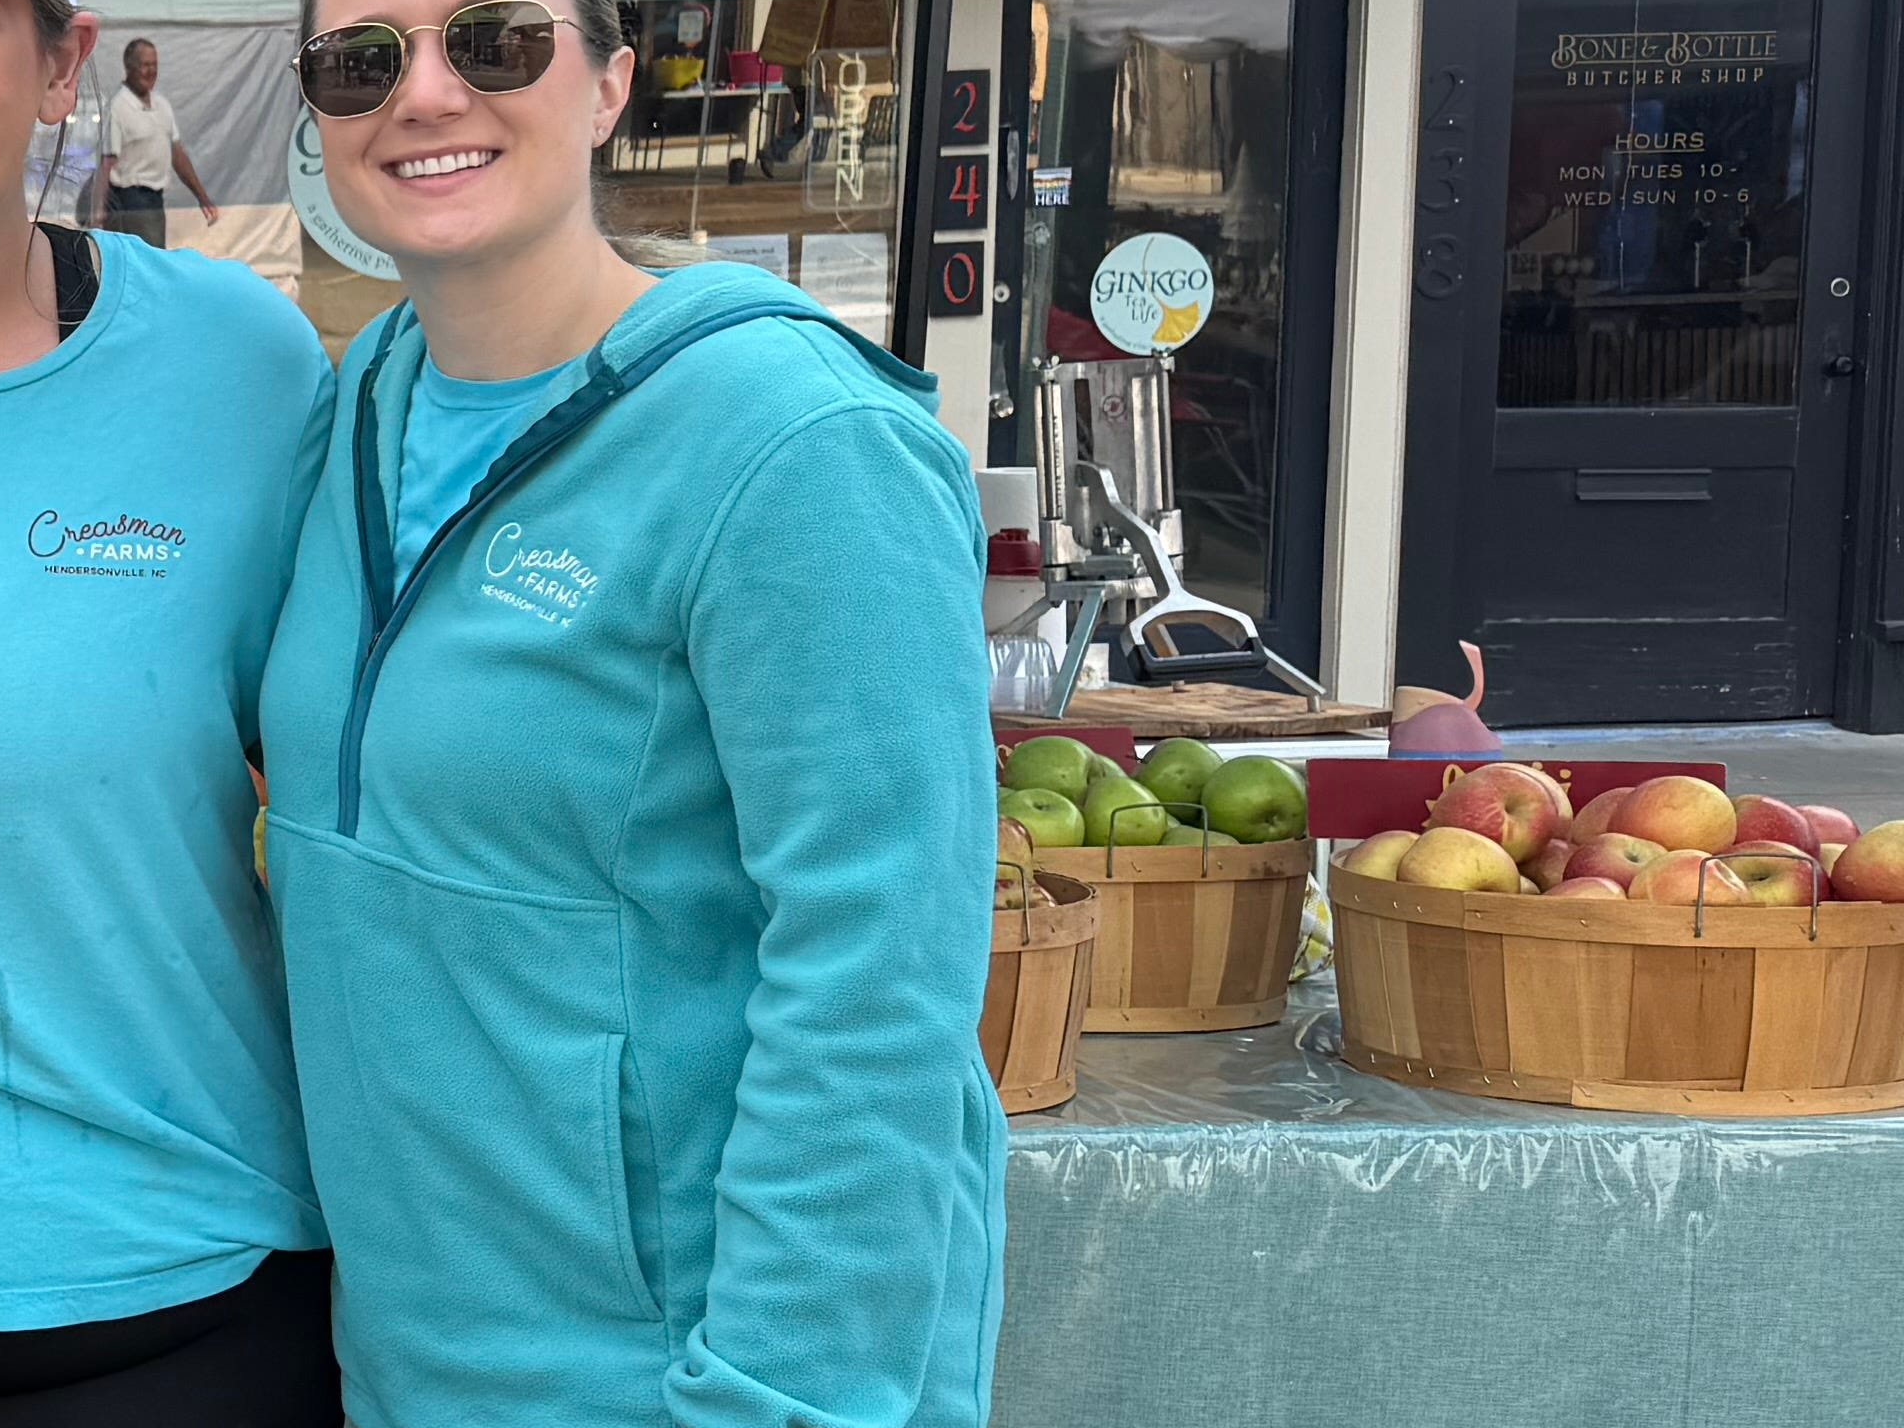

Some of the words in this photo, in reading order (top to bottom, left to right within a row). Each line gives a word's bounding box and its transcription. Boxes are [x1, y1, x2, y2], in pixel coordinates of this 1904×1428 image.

[1641, 37, 1657, 58] &
[1665, 32, 1777, 67] BOTTLE
[1567, 70, 1681, 86] BUTCHER
[1701, 67, 1764, 84] SHOP
[1614, 132, 1705, 150] HOURS
[1559, 165, 1606, 181] MON
[1629, 164, 1683, 180] TUES
[1035, 192, 1070, 207] HERE
[1564, 191, 1612, 206] WED
[1632, 190, 1677, 205] SUN
[1095, 269, 1208, 304] GINKGO
[1125, 295, 1146, 308] Tea
[28, 509, 186, 558] Creasman
[89, 543, 169, 561] FARMS
[151, 569, 168, 578] NC
[524, 572, 581, 609] FARMS
